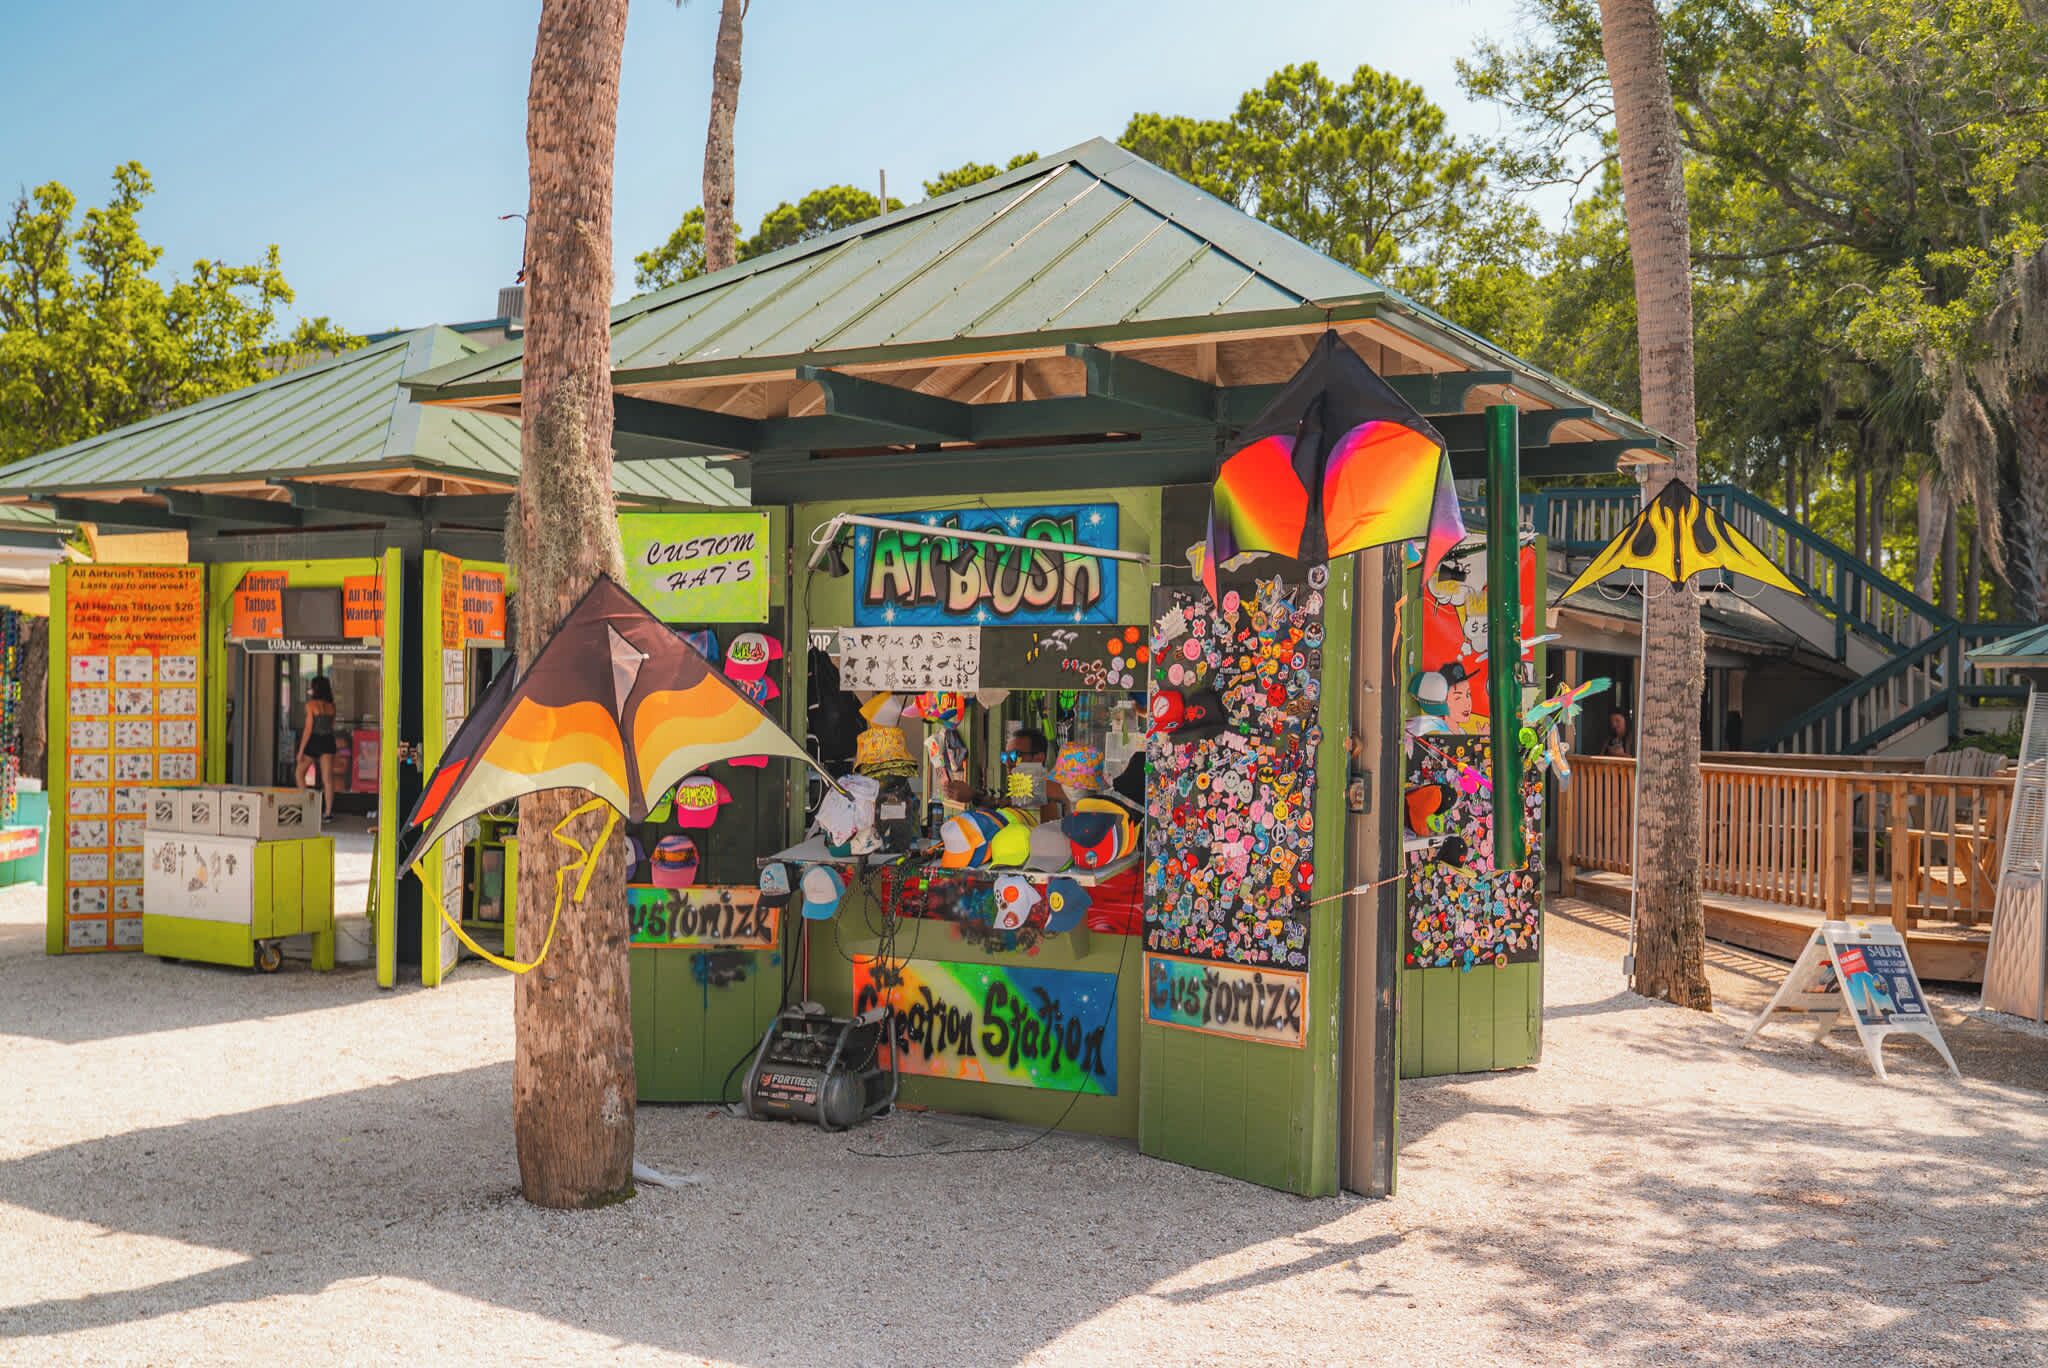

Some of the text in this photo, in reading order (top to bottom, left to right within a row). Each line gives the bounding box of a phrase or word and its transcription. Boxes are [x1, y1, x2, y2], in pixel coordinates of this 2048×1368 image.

[647, 533, 755, 565] CUSTOM
[72, 569, 196, 579] All Airbrush Tattoos $10
[80, 582, 107, 590] Lasts
[110, 583, 123, 592] up
[126, 582, 136, 590] to
[75, 602, 89, 610] All
[92, 602, 128, 611] Henna
[131, 602, 171, 611] Tattoos
[244, 597, 276, 612] Tattoos
[104, 616, 118, 624] up
[252, 618, 267, 633] $10
[71, 632, 197, 641] All Tattoos Are Waterproof
[982, 981, 1106, 1075] Station
[771, 1073, 817, 1088] FORTRESS
